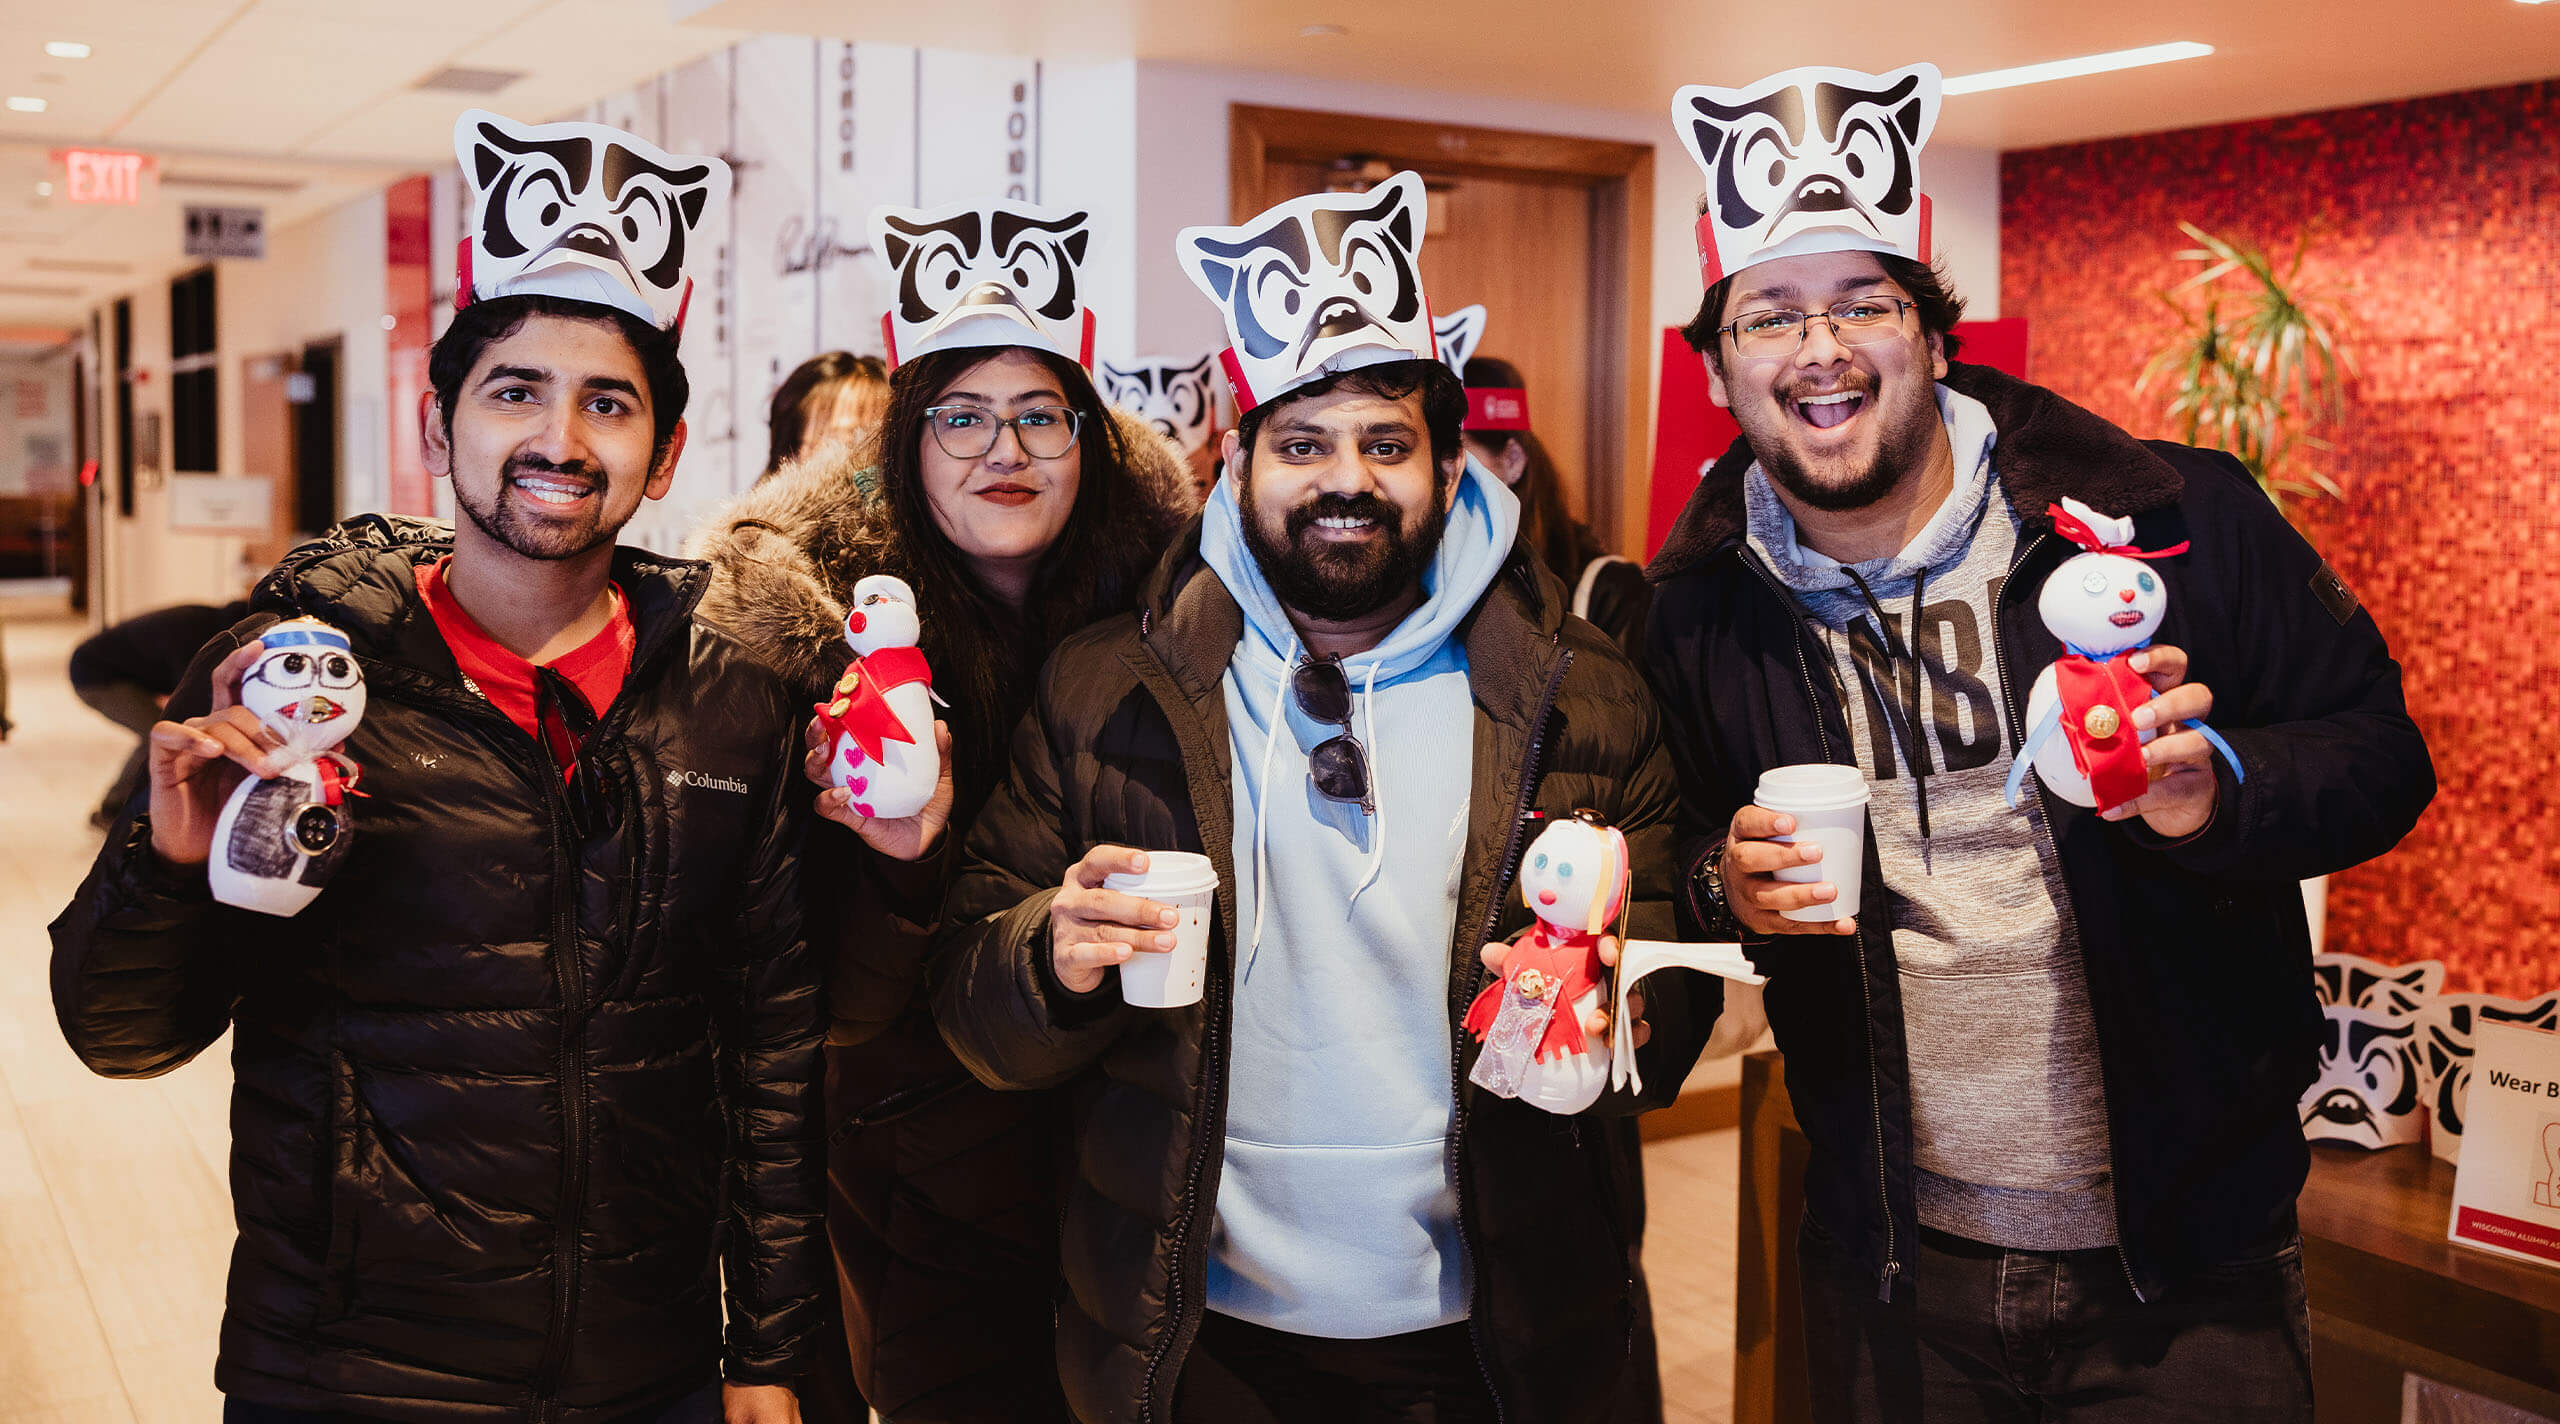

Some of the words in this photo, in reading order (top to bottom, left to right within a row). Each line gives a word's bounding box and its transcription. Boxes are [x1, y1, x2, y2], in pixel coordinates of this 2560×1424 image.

[66, 151, 143, 205] EXIT
[684, 770, 748, 794] Columbia
[2489, 1069, 2542, 1094] Wear
[2471, 1220, 2516, 1238] WISCONSIN
[2517, 1233, 2549, 1246] ALUMNI
